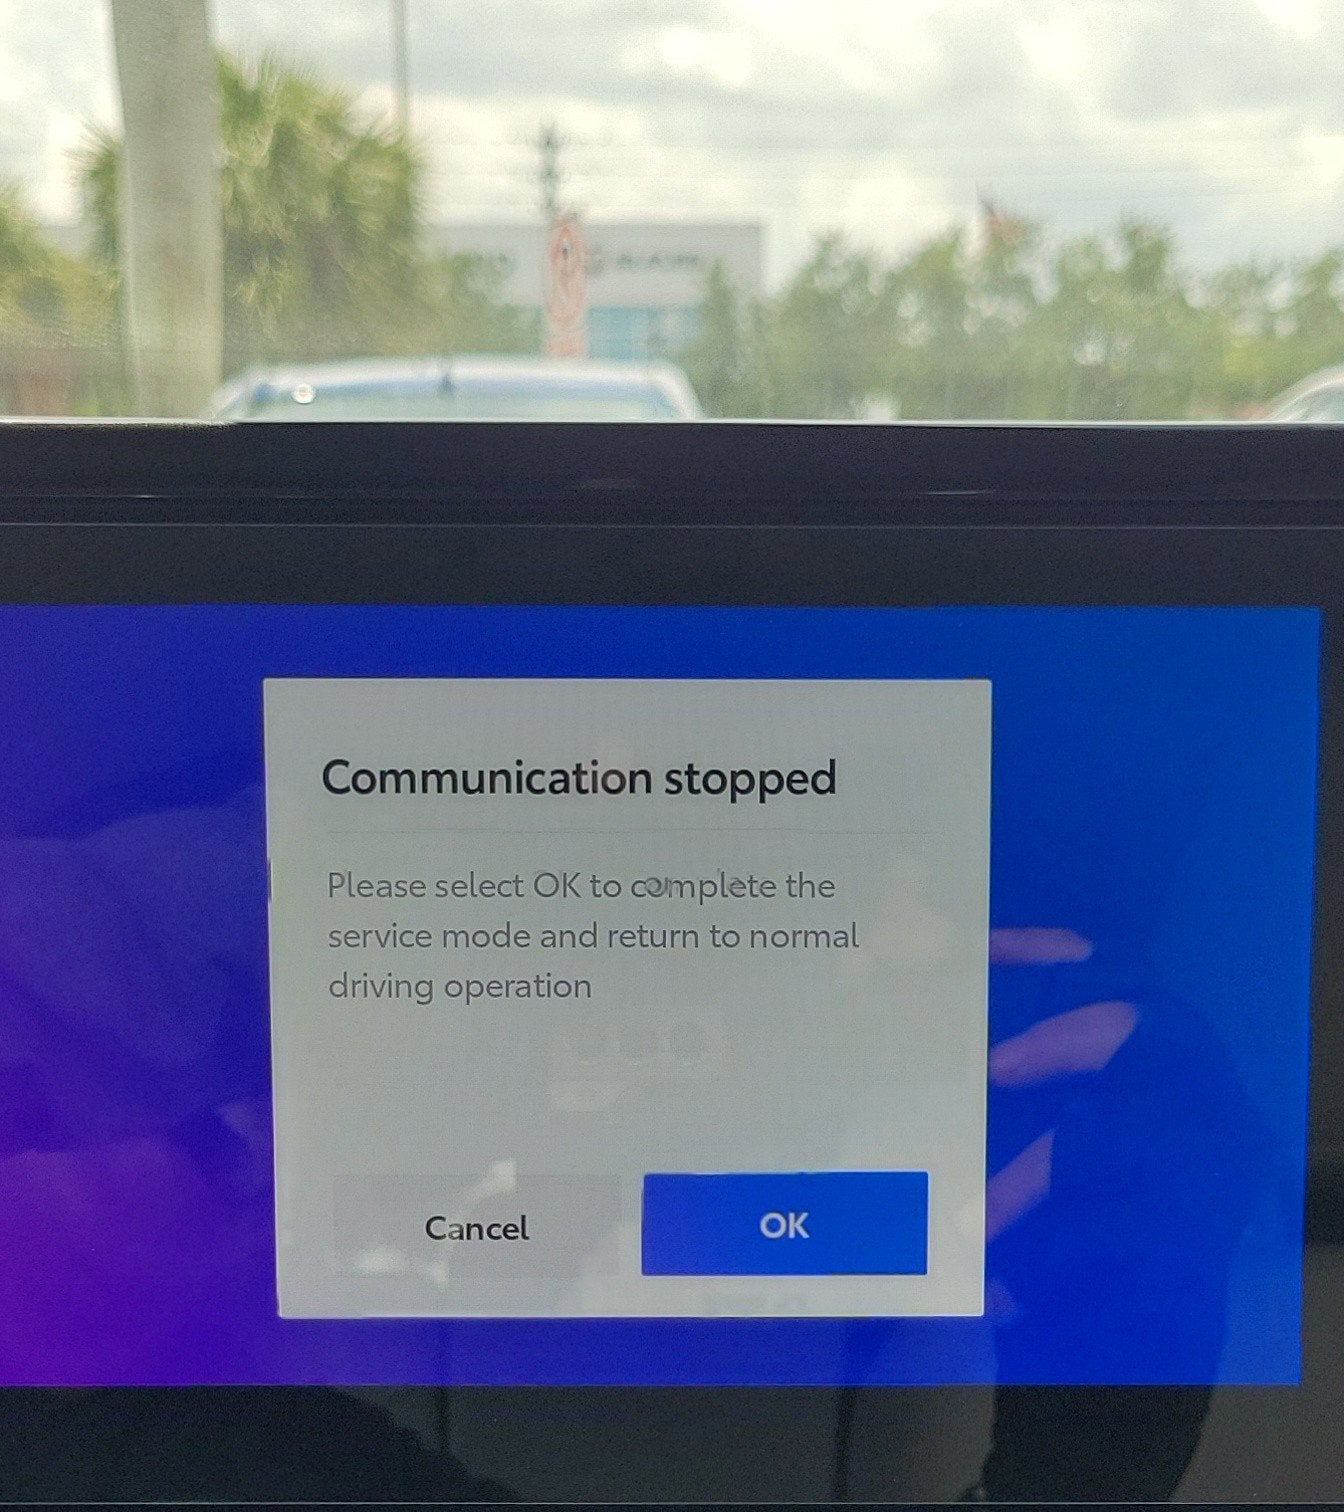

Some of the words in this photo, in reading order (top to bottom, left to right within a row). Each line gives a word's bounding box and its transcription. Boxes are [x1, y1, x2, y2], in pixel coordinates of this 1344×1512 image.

[322, 758, 652, 795] Communication
[664, 758, 837, 804] stopped
[328, 870, 427, 899] Please
[435, 870, 525, 899] select
[533, 872, 581, 899] OK
[590, 874, 622, 899] to
[630, 870, 777, 905] complete
[785, 870, 836, 899] the
[328, 921, 433, 949] service
[442, 921, 531, 949] mode
[540, 921, 598, 949] and
[608, 924, 699, 949] return
[709, 924, 742, 949] to
[750, 921, 860, 949] normal
[328, 971, 434, 1006] driving
[444, 972, 592, 1006] operation
[425, 1214, 530, 1242] Cancel
[760, 1212, 810, 1239] OK
